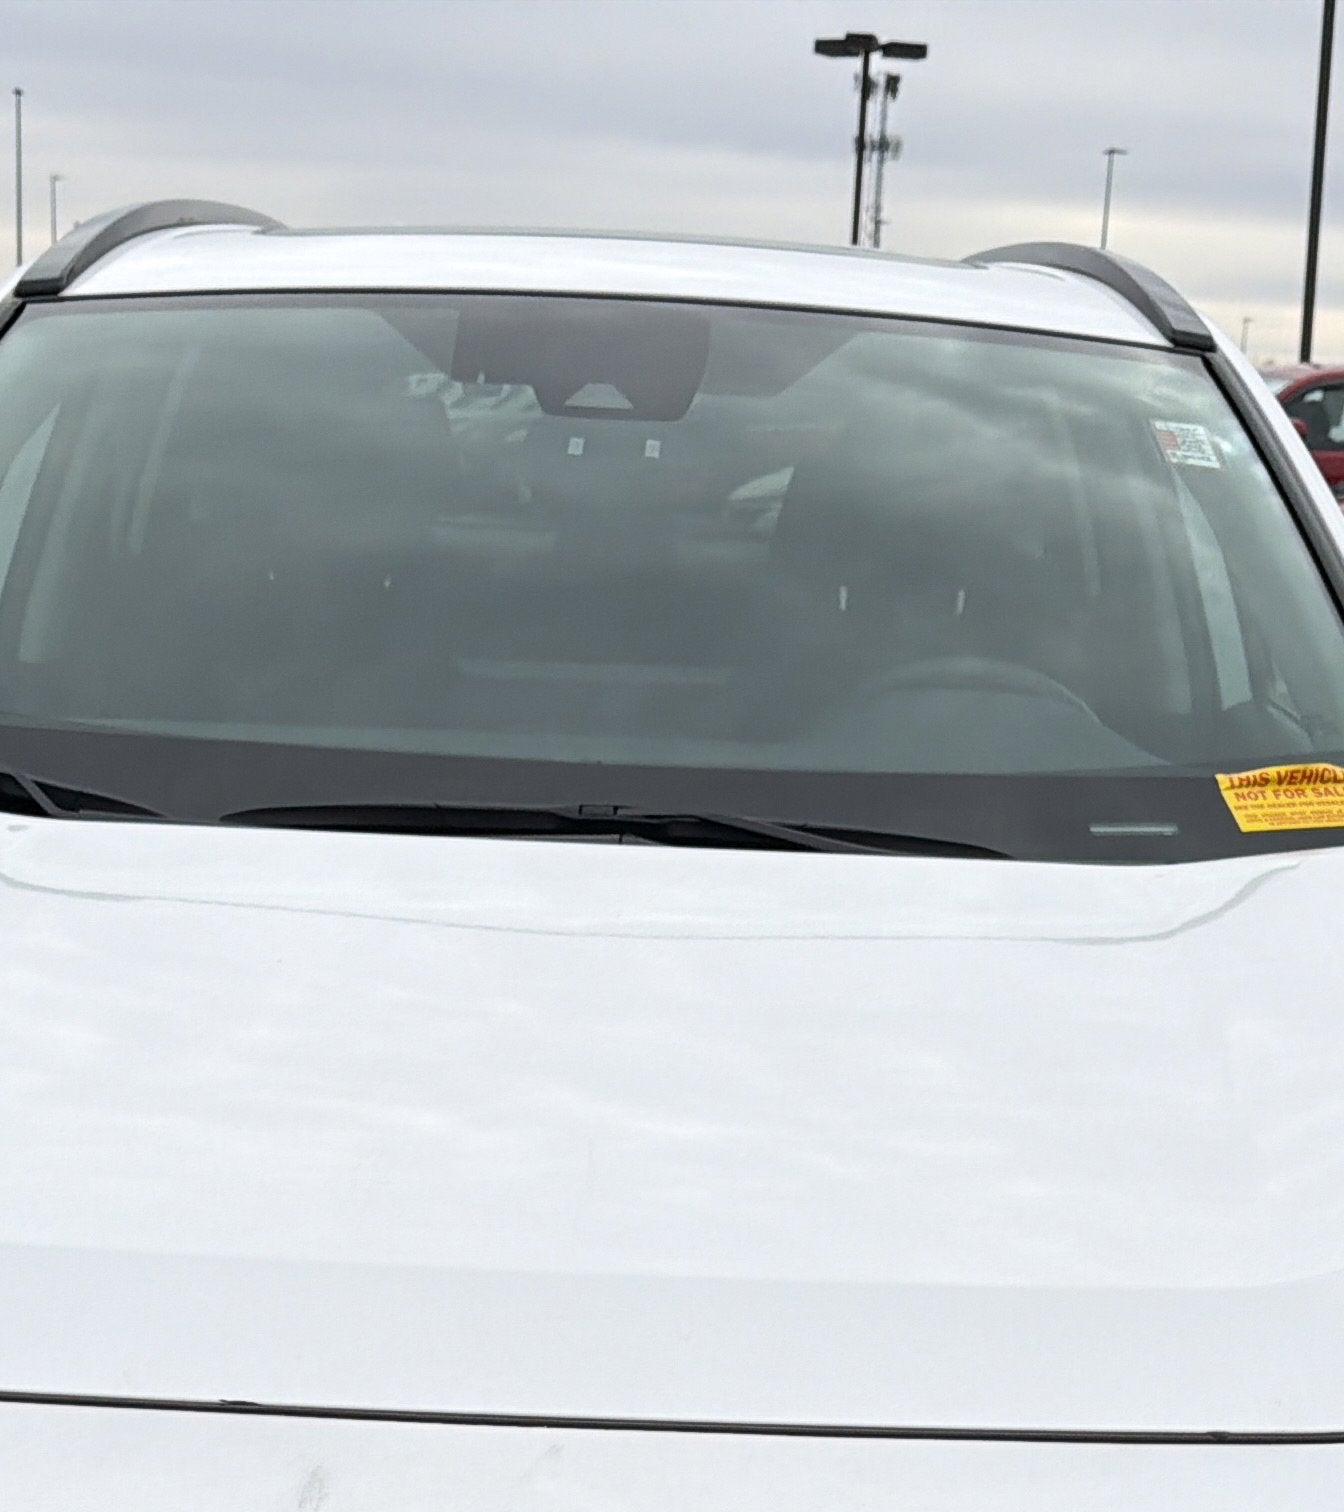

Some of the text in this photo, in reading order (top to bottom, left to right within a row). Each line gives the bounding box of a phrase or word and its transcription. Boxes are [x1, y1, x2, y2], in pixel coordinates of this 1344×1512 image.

[1228, 772, 1271, 790] THIS
[1234, 789, 1267, 802] NOT
[1273, 788, 1308, 801] FOR
